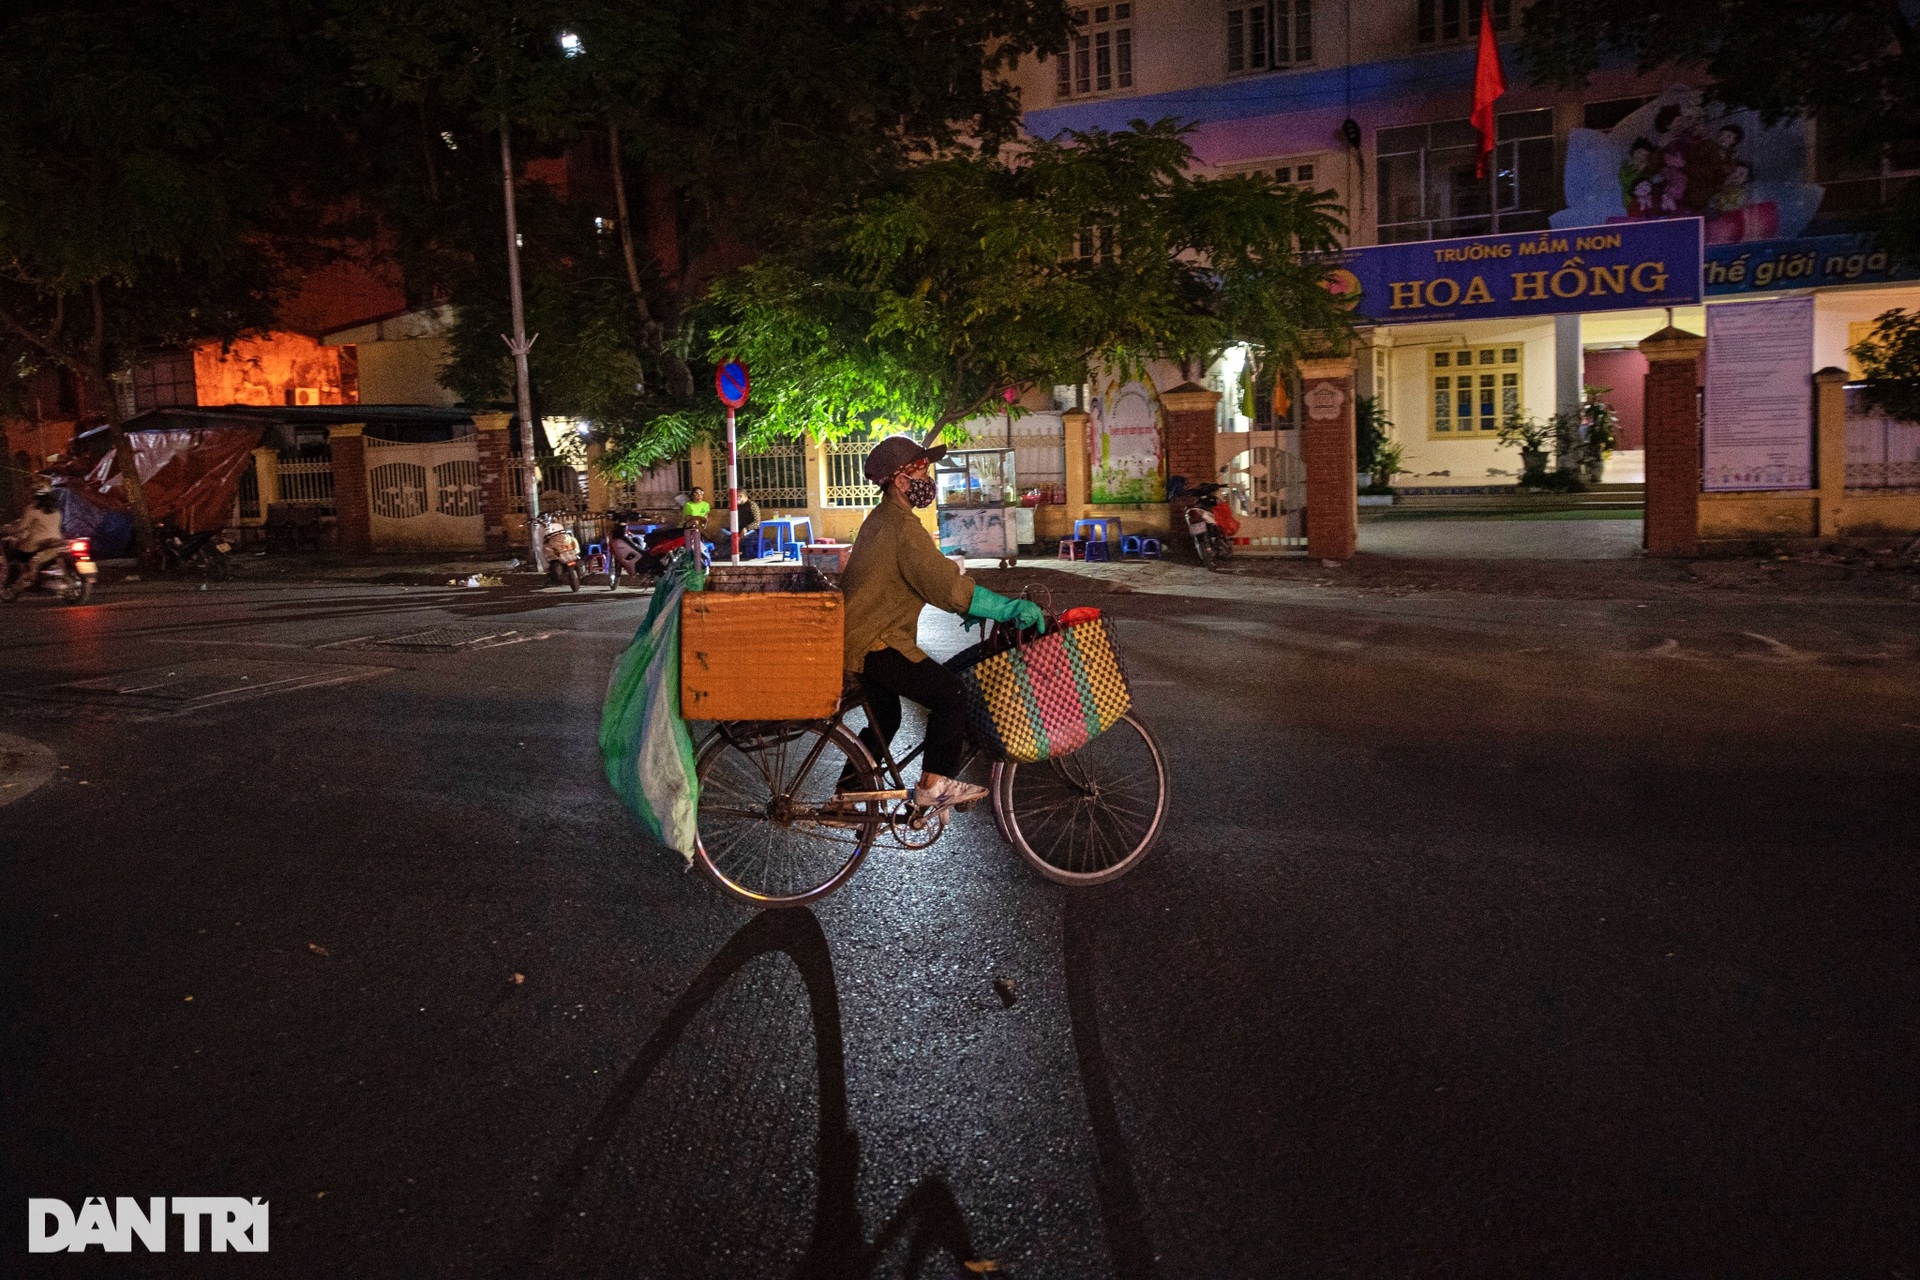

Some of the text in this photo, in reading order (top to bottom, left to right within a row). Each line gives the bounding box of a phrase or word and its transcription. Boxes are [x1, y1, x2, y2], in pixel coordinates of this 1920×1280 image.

[1434, 232, 1622, 263] TRƯỜNG MẦM NON
[1388, 256, 1670, 311] HOA HỒNG
[1755, 251, 1817, 286] giới
